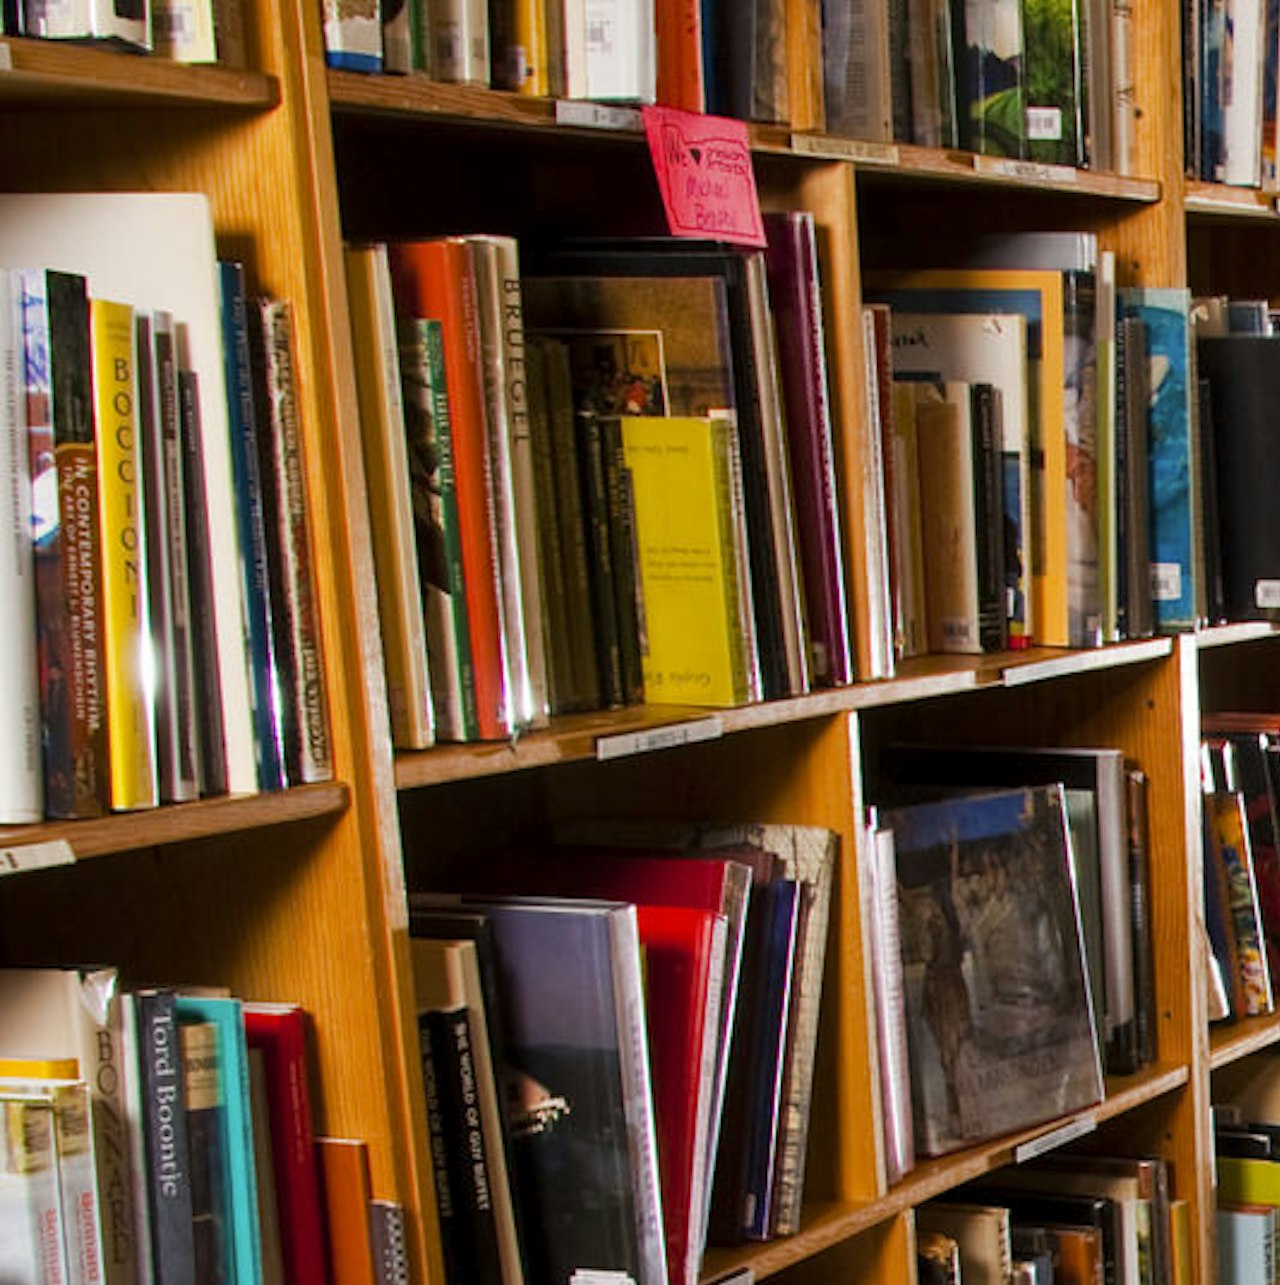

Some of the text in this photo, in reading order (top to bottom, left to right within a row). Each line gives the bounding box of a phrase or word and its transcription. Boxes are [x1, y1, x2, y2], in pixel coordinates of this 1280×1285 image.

[503, 278, 530, 442] BRUEGEL
[76, 457, 87, 479] IN
[76, 485, 97, 642] CONTEMPORARY
[96, 1029, 125, 1264] BONNARD
[152, 1006, 184, 1198] Tord Boontje
[458, 1052, 476, 1104] WORLD
[464, 1106, 480, 1127] OF
